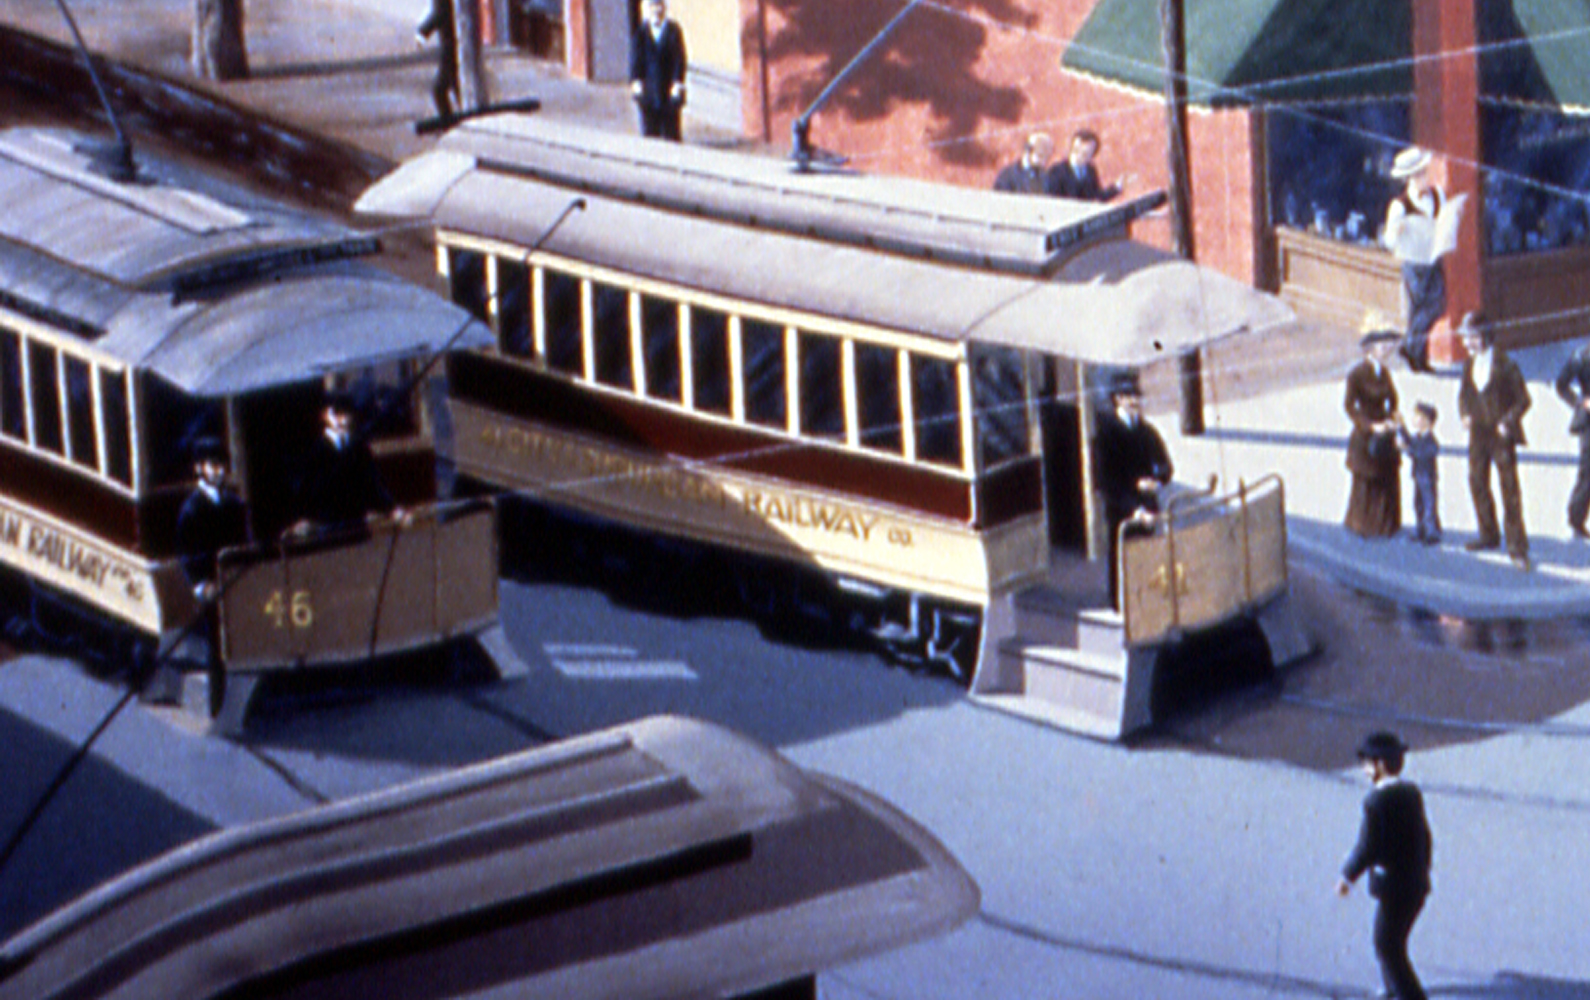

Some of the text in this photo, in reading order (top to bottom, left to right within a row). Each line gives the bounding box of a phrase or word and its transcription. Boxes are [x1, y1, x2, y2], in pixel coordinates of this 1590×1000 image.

[742, 488, 880, 541] RAILWAY
[27, 523, 112, 589] RAILWAY
[263, 589, 314, 628] 46
